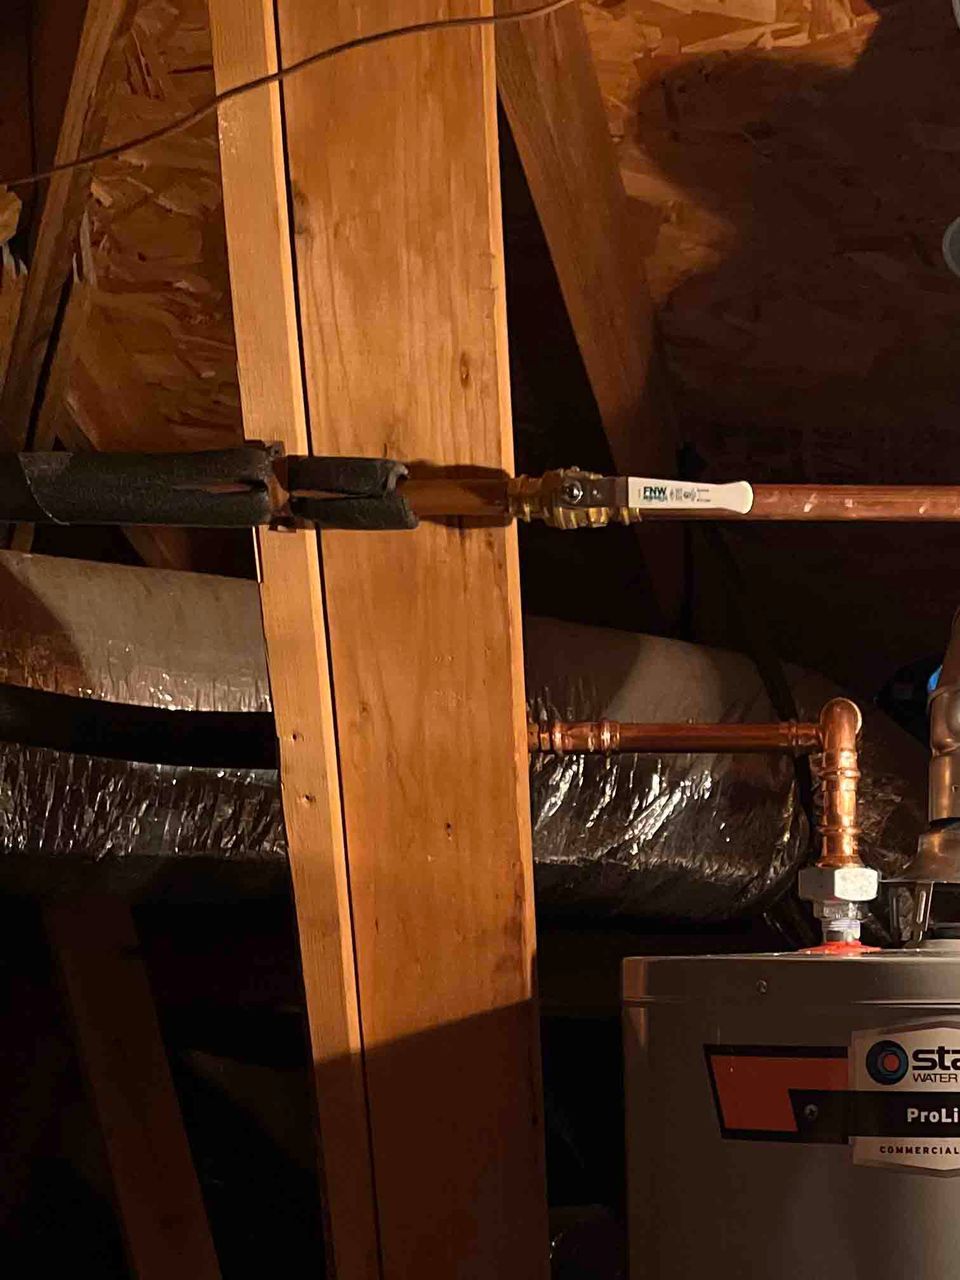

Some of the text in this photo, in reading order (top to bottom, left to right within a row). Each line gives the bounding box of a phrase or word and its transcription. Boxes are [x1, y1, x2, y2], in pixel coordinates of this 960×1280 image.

[644, 486, 667, 496] FNW
[912, 1072, 958, 1083] WATER
[879, 1146, 960, 1155] COMMERCIAL
